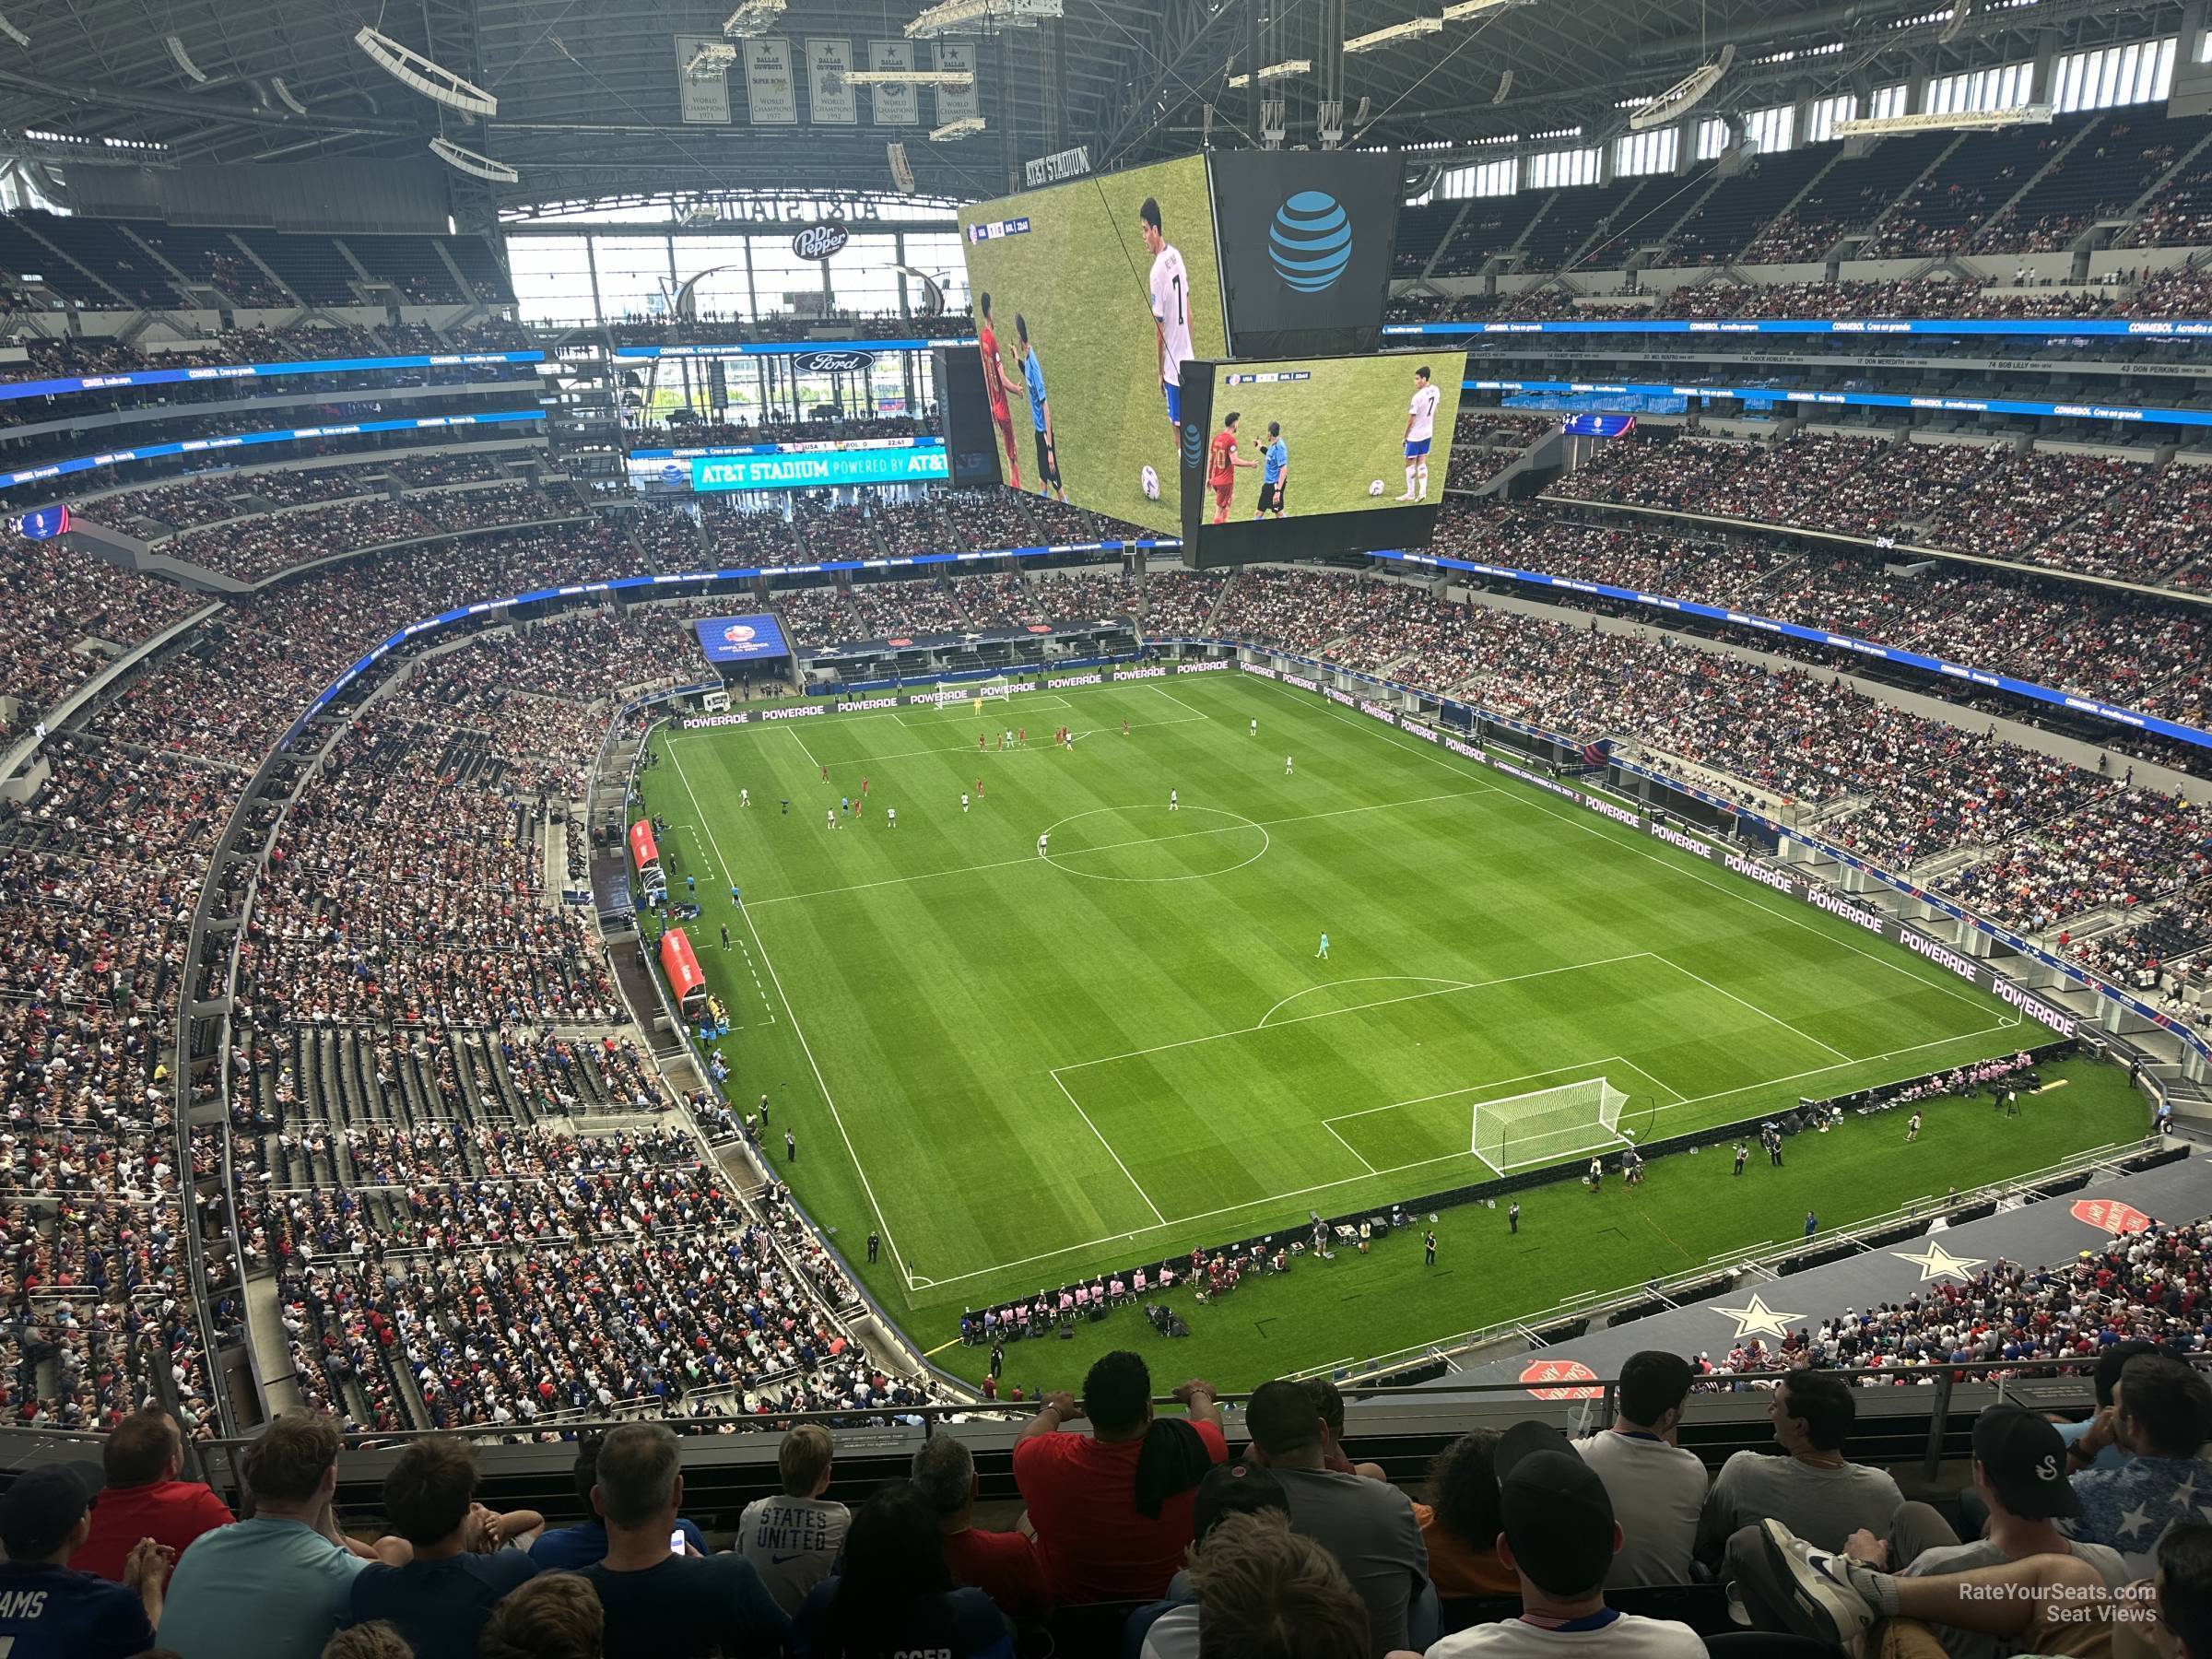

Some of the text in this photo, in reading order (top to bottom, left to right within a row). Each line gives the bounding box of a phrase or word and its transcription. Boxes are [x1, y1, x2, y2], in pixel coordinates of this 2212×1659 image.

[1026, 146, 1091, 186] AT&T STADIUM
[800, 227, 846, 257] Pepper
[816, 225, 835, 240] Dr
[1172, 275, 1184, 325] 7
[1832, 323, 1865, 331] CONMEBOL
[810, 353, 859, 370] Ford
[1428, 396, 1434, 415] 7
[1787, 392, 1815, 401] CONMEBOL
[1910, 399, 1943, 407] CONMEBOL
[2054, 406, 2091, 415] CONMEBOL
[702, 464, 746, 483] AT&T
[750, 460, 829, 481] STADIUM
[833, 461, 887, 474] POWERED
[891, 460, 904, 472] BY
[908, 454, 948, 472] AT&T
[1113, 667, 1166, 681] POWERADE
[1177, 661, 1229, 674] POWERADE
[1240, 661, 1276, 679] POWERADE
[980, 682, 1036, 697] POWERADE
[1048, 674, 1102, 689] POWERADE
[1282, 673, 1317, 692] POWERADE
[838, 697, 897, 712] POWERADE
[910, 690, 967, 705] POWERADE
[684, 713, 747, 729] POWERADE
[762, 705, 825, 720] POWERADE
[1360, 701, 1394, 724] POWERADE
[1401, 719, 1438, 743] POWERADE
[1446, 737, 1486, 764] POWERADE
[1586, 795, 1640, 828] POWERADE
[1651, 822, 1711, 859] POWERADE
[1724, 853, 1792, 893] POWERADE
[1808, 889, 1883, 934] POWERADE
[1900, 929, 1975, 982] POWERADE
[1992, 978, 2074, 1038] POWERADE
[760, 1506, 826, 1529] STATES
[757, 1530, 826, 1551] UNITED
[0, 1591, 48, 1618] AMS
